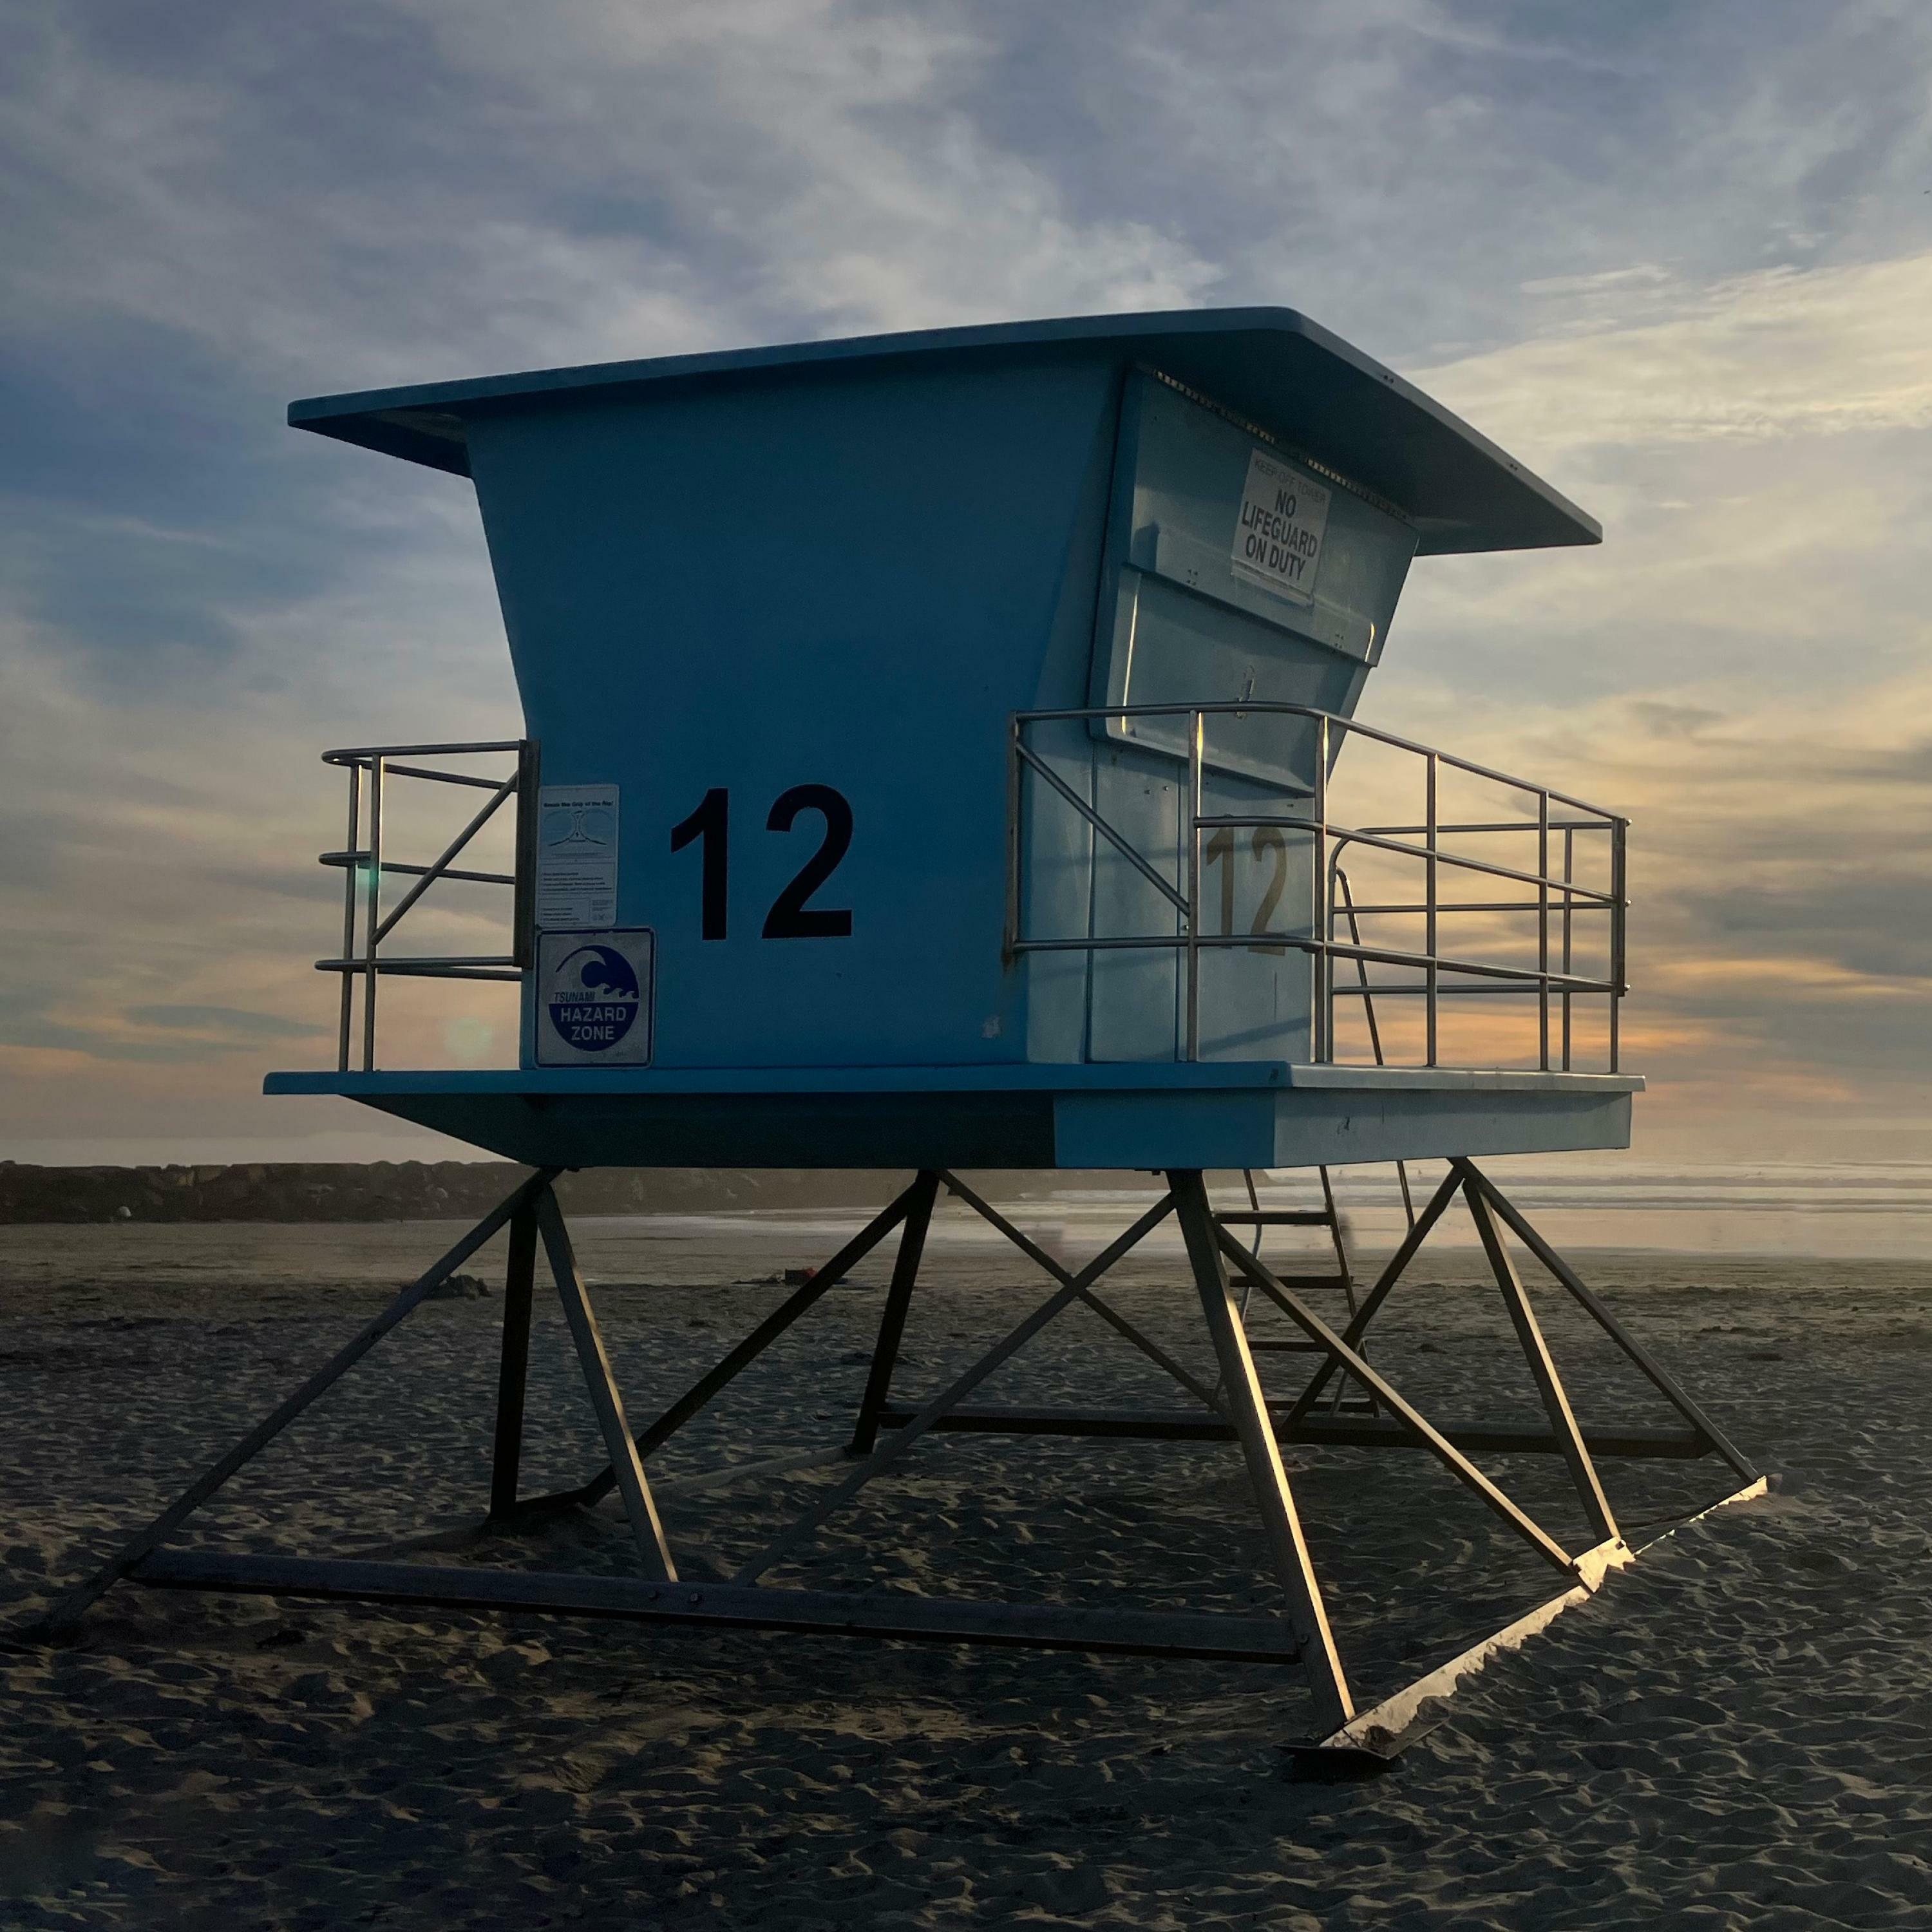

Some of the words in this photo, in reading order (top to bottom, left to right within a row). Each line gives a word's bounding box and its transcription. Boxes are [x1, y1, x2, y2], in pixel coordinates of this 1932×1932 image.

[1275, 488, 1296, 518] NO
[1242, 501, 1318, 558] LIFEGUARD
[1245, 534, 1267, 564] ON
[1269, 545, 1306, 580] DUTY
[670, 784, 853, 941] 12
[1206, 826, 1287, 956] 12
[554, 991, 596, 1003] TSUNAMI
[560, 1007, 627, 1022] HAZARD
[571, 1025, 615, 1041] ZONE
